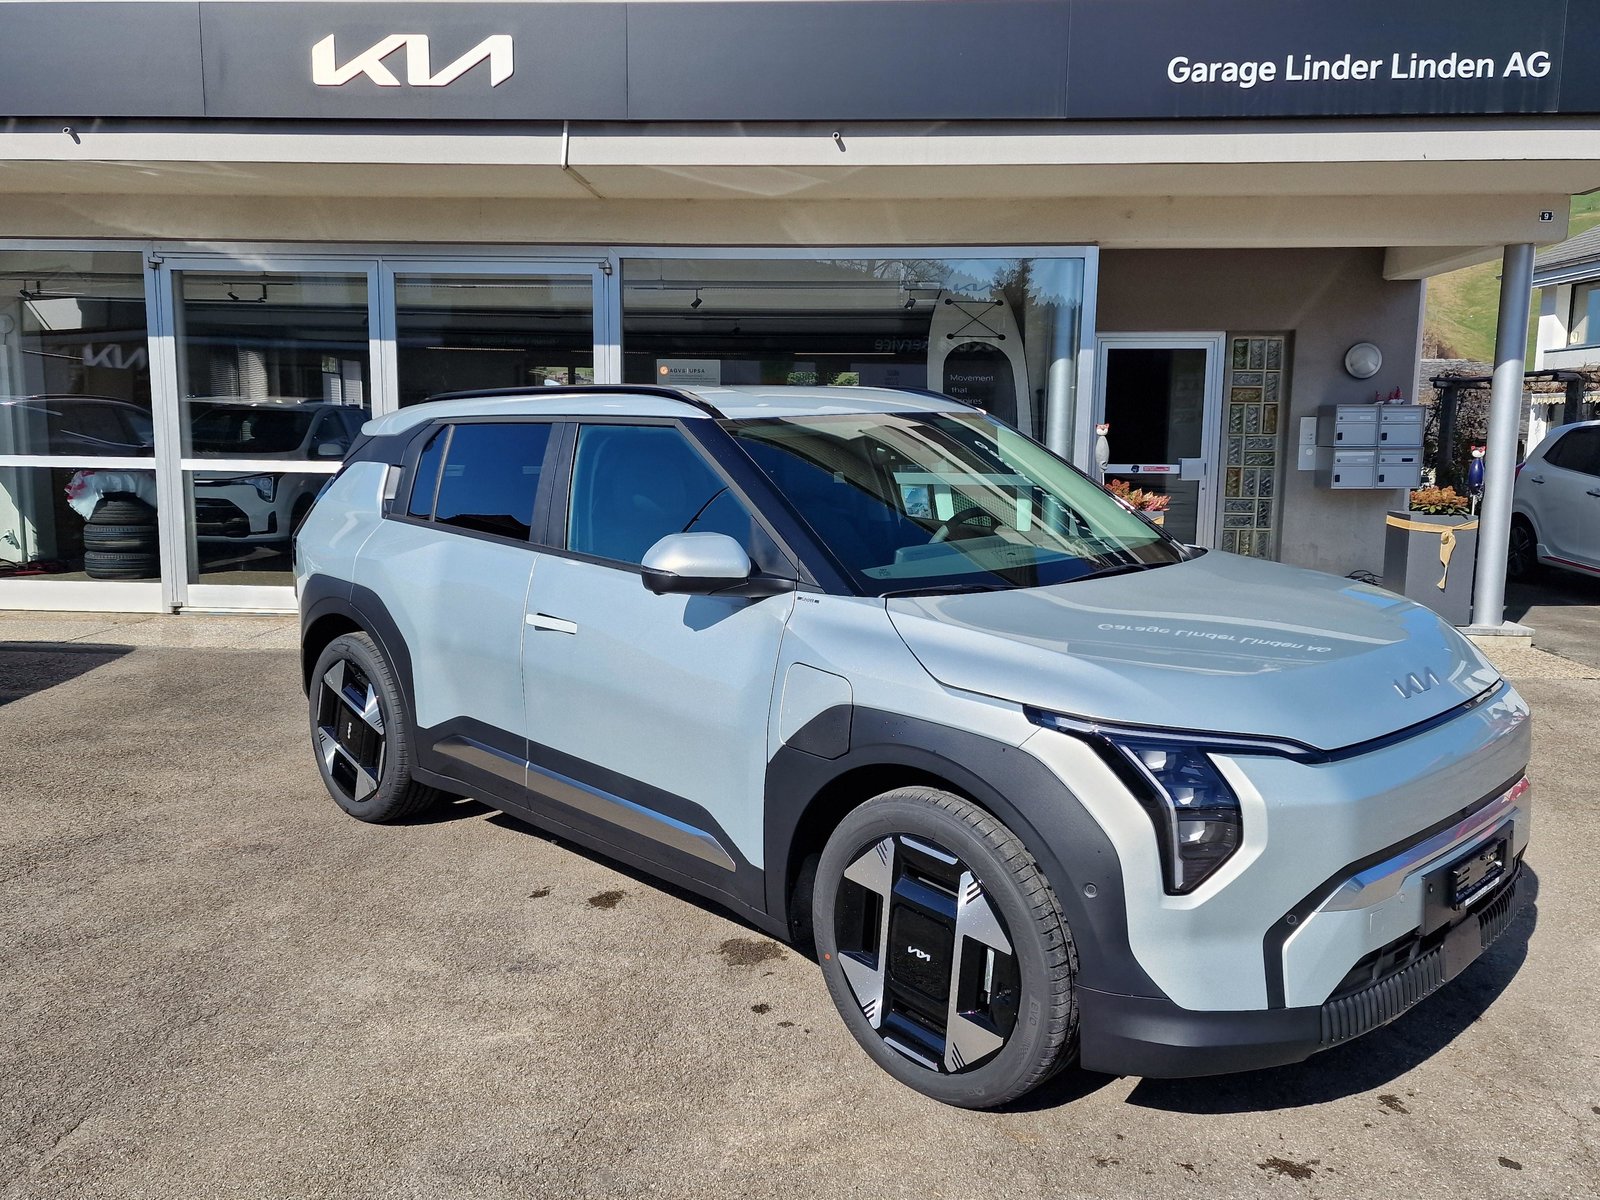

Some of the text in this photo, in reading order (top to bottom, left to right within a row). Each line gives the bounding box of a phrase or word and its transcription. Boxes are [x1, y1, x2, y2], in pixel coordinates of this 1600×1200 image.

[312, 33, 514, 88] KIA
[1167, 51, 1552, 88] Garage Linder Linden AG
[1392, 667, 1440, 699] KIA
